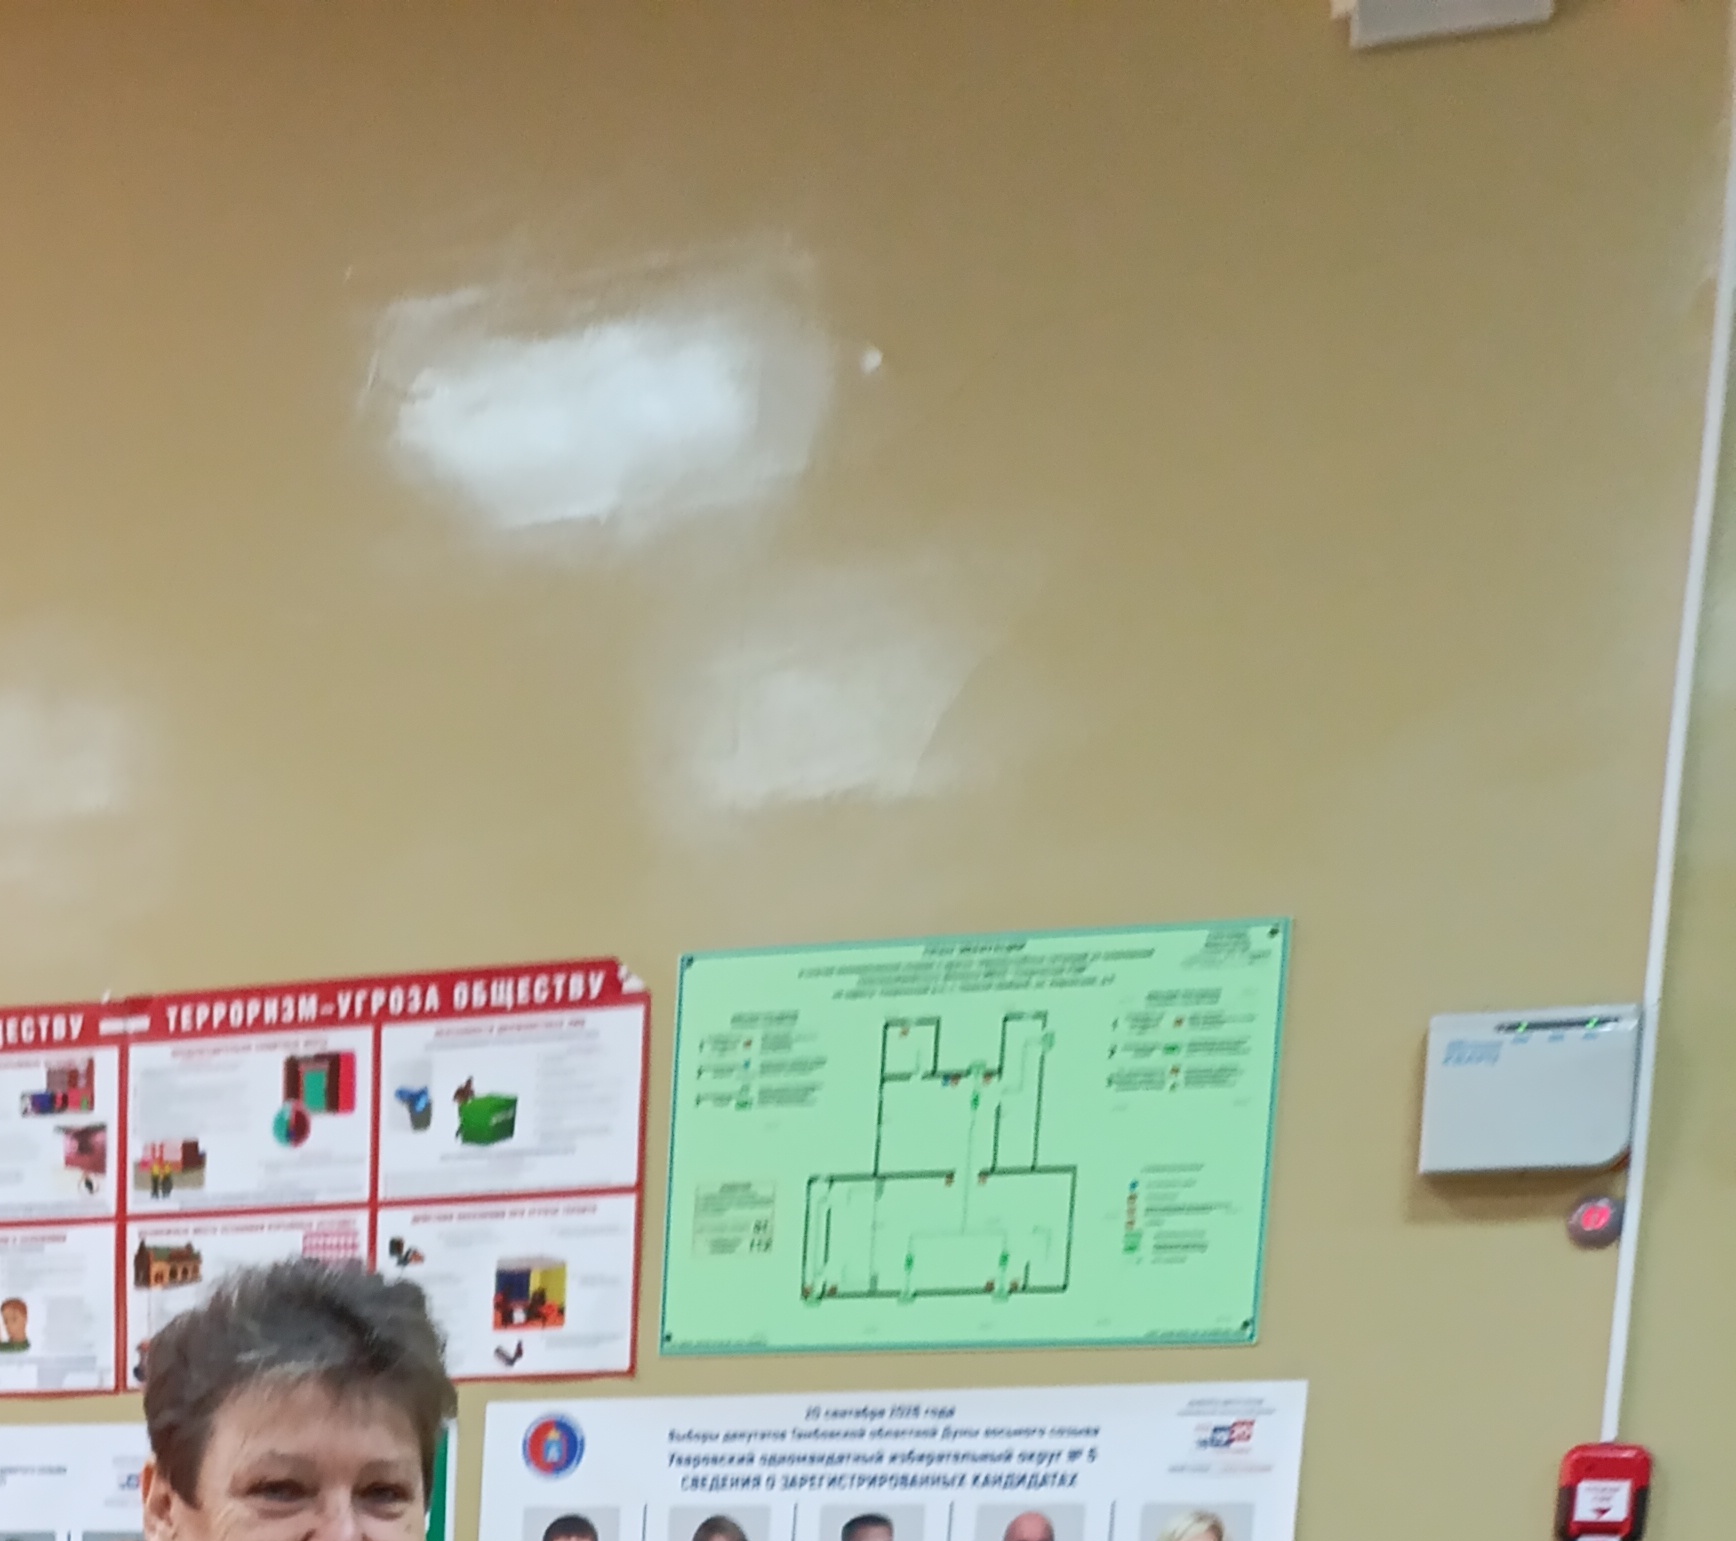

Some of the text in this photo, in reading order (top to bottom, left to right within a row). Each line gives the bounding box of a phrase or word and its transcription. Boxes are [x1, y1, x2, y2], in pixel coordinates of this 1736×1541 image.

[453, 970, 607, 1011] ОБЩЕСТВУ
[680, 1474, 762, 1492] СВЕДЕНИЯ
[779, 1472, 967, 1492] ЗАРЕГИСТРИРОВАННЫХ
[971, 1471, 1079, 1491] КАНДИДАТАХ
